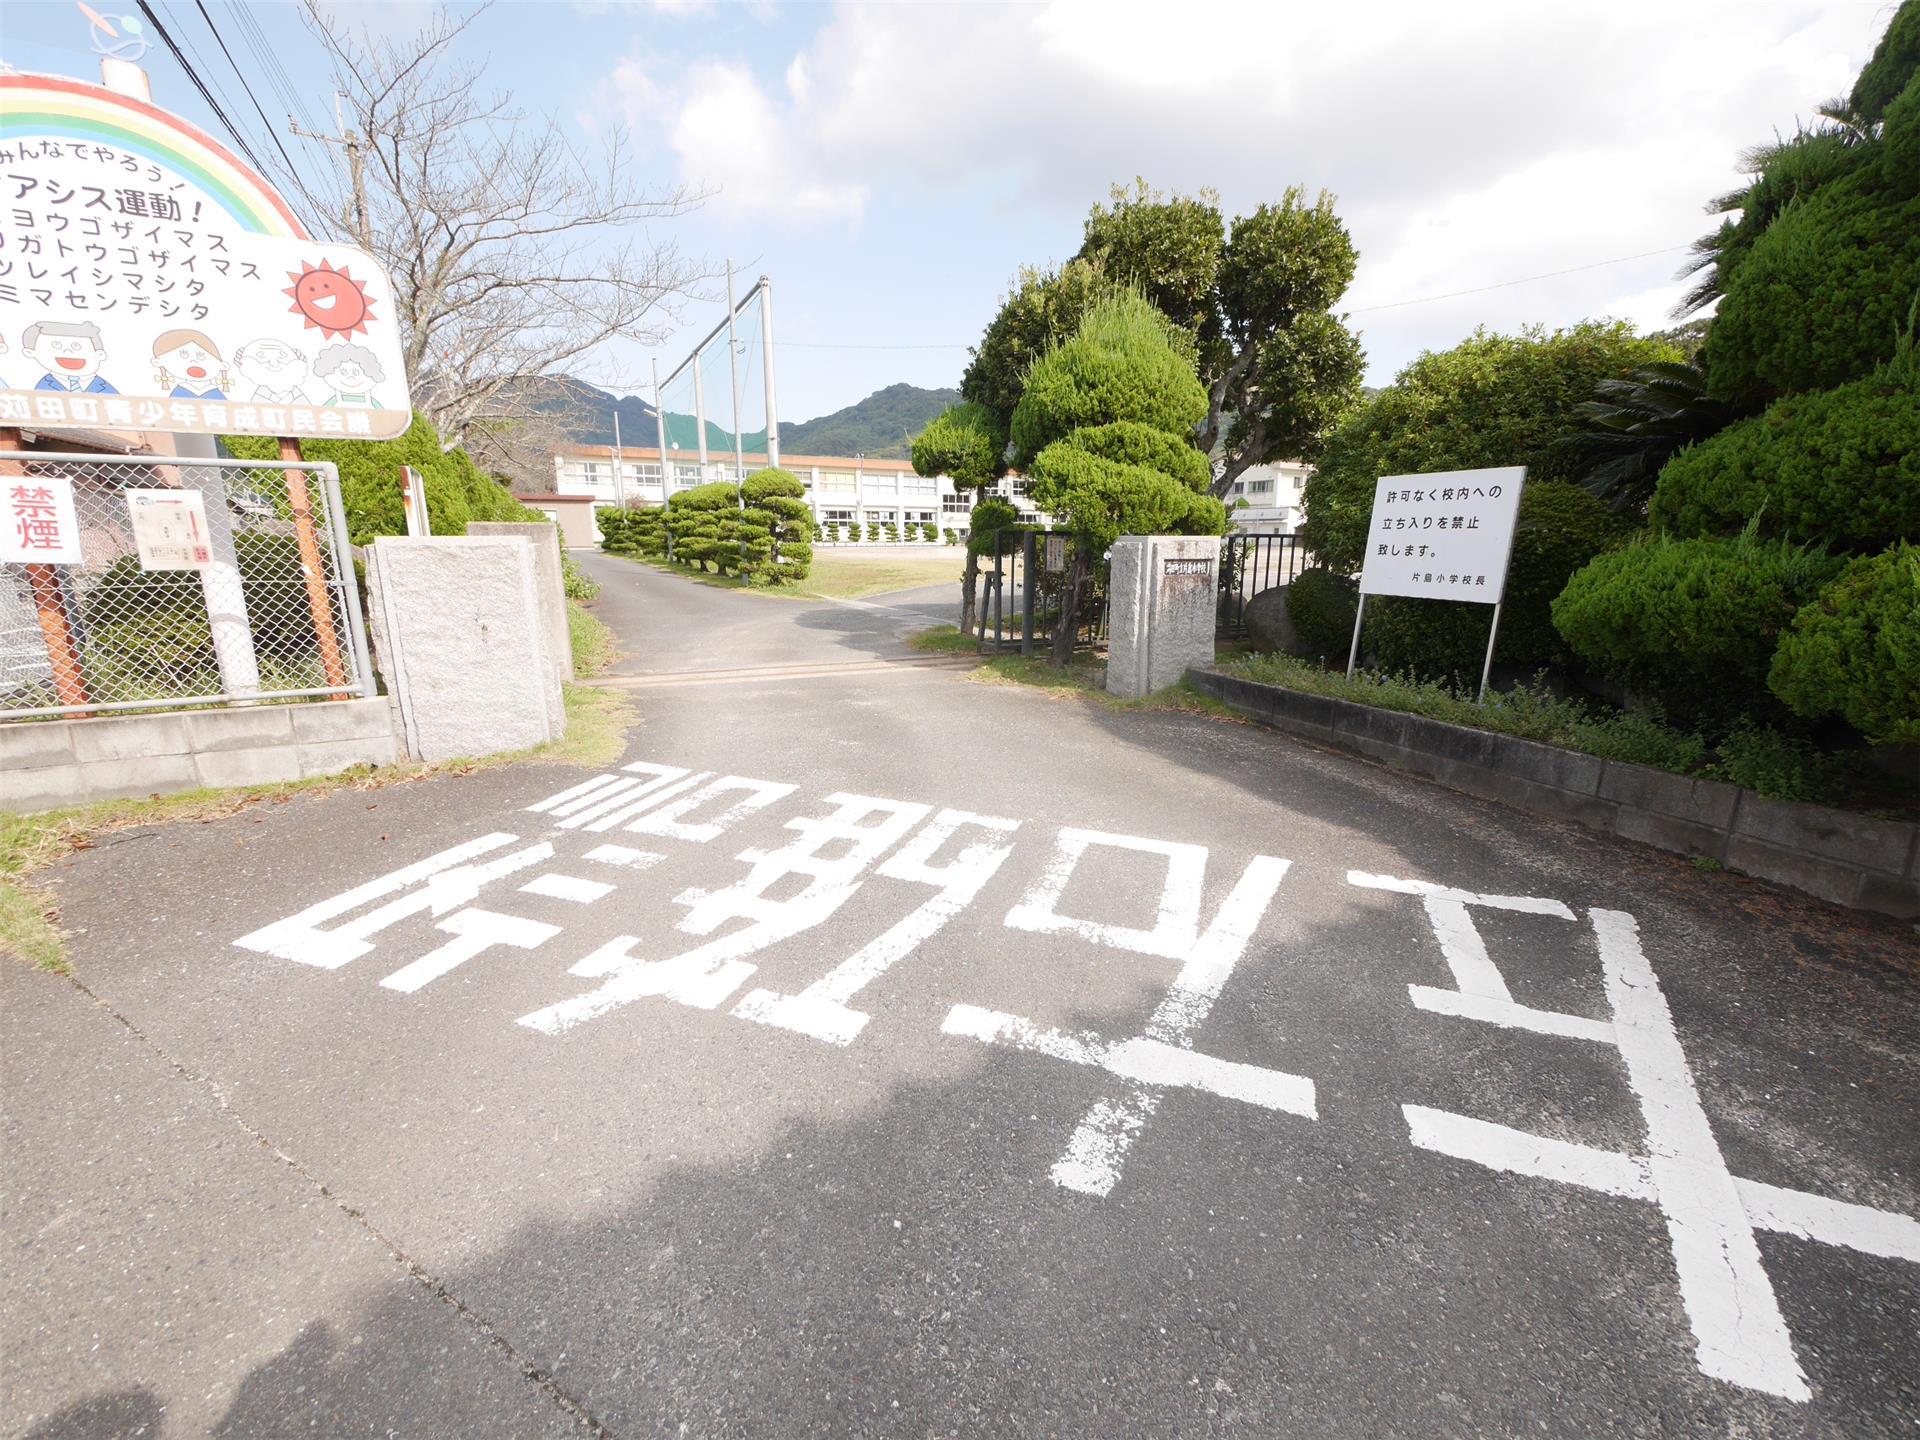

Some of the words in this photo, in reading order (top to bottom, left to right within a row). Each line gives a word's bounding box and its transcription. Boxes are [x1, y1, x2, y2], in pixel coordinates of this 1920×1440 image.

[0, 174, 202, 223] アシス運動！
[0, 208, 228, 252] ヨウゴザイマス
[1386, 485, 1502, 504] 許可なく校内への
[10, 485, 63, 549] 禁煙
[1381, 515, 1480, 530] 立ち入りを禁止
[1377, 544, 1436, 558] 致します。
[1411, 572, 1486, 586] 片島小学校長
